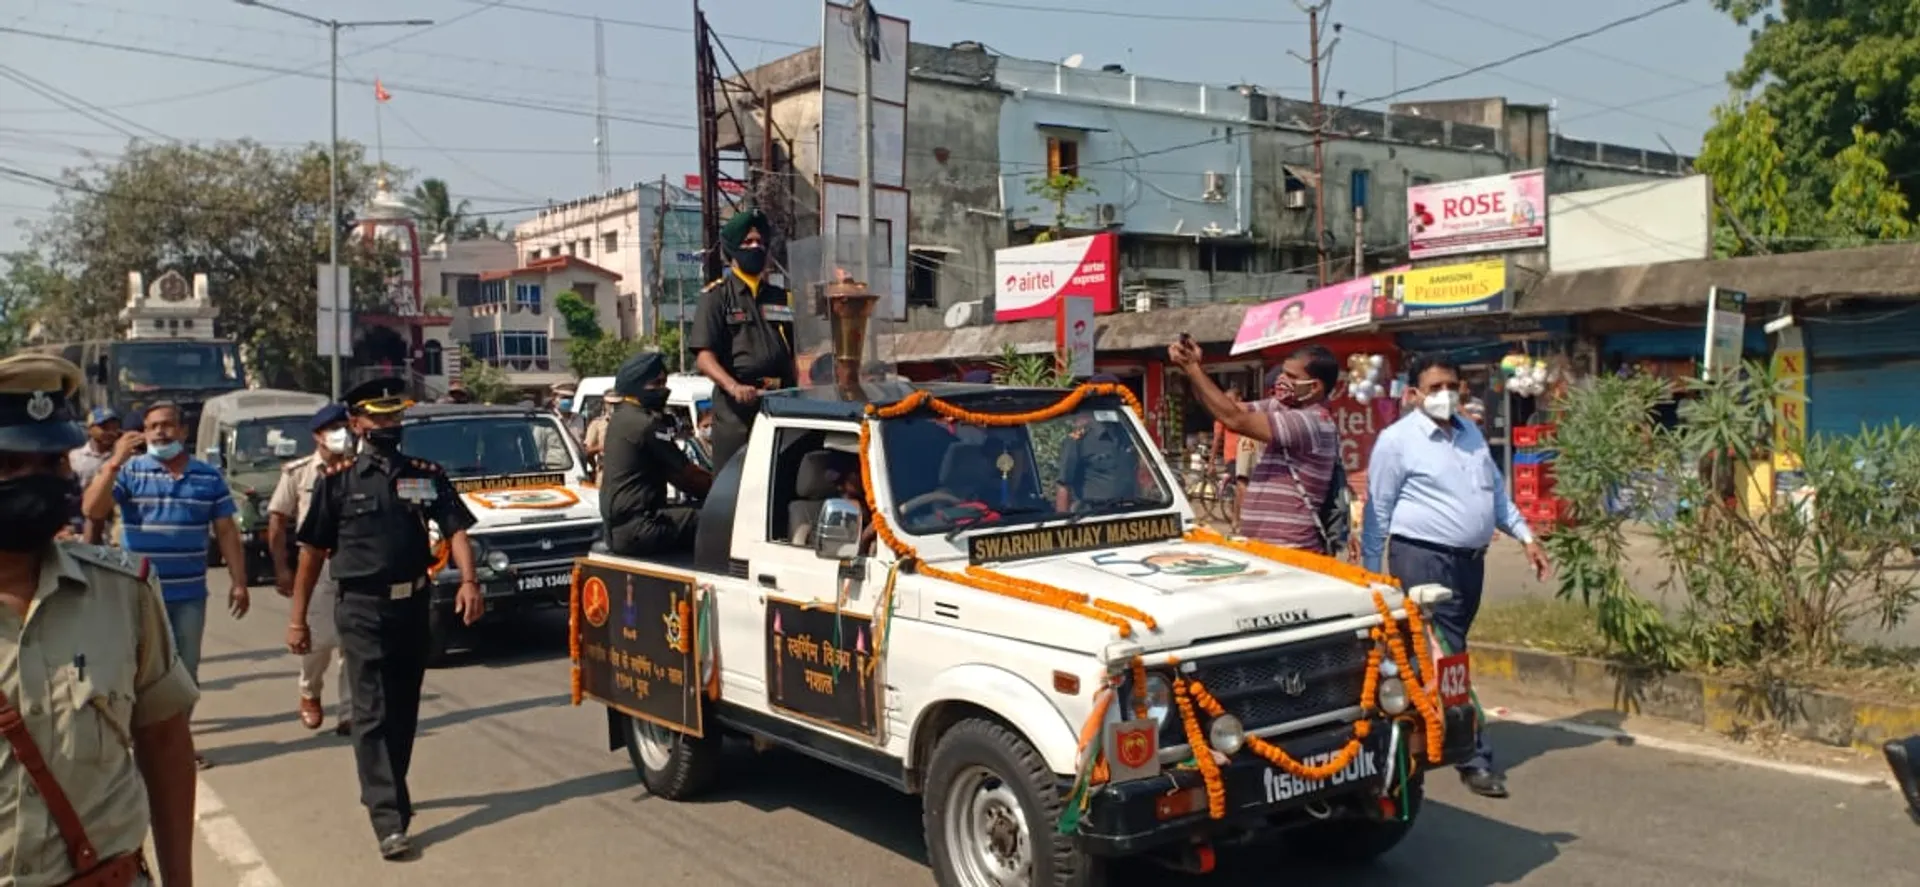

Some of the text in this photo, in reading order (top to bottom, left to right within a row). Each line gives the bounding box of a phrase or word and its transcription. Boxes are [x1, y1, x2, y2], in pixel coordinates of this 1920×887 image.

[1442, 192, 1505, 219] ROSE
[1019, 270, 1055, 292] airtel
[1071, 273, 1106, 287] express
[1082, 262, 1106, 273] airtel
[974, 518, 1179, 560] SWARNIM VIJAY MASHAAL
[804, 668, 834, 695] मशाल
[1440, 664, 1467, 699] 432
